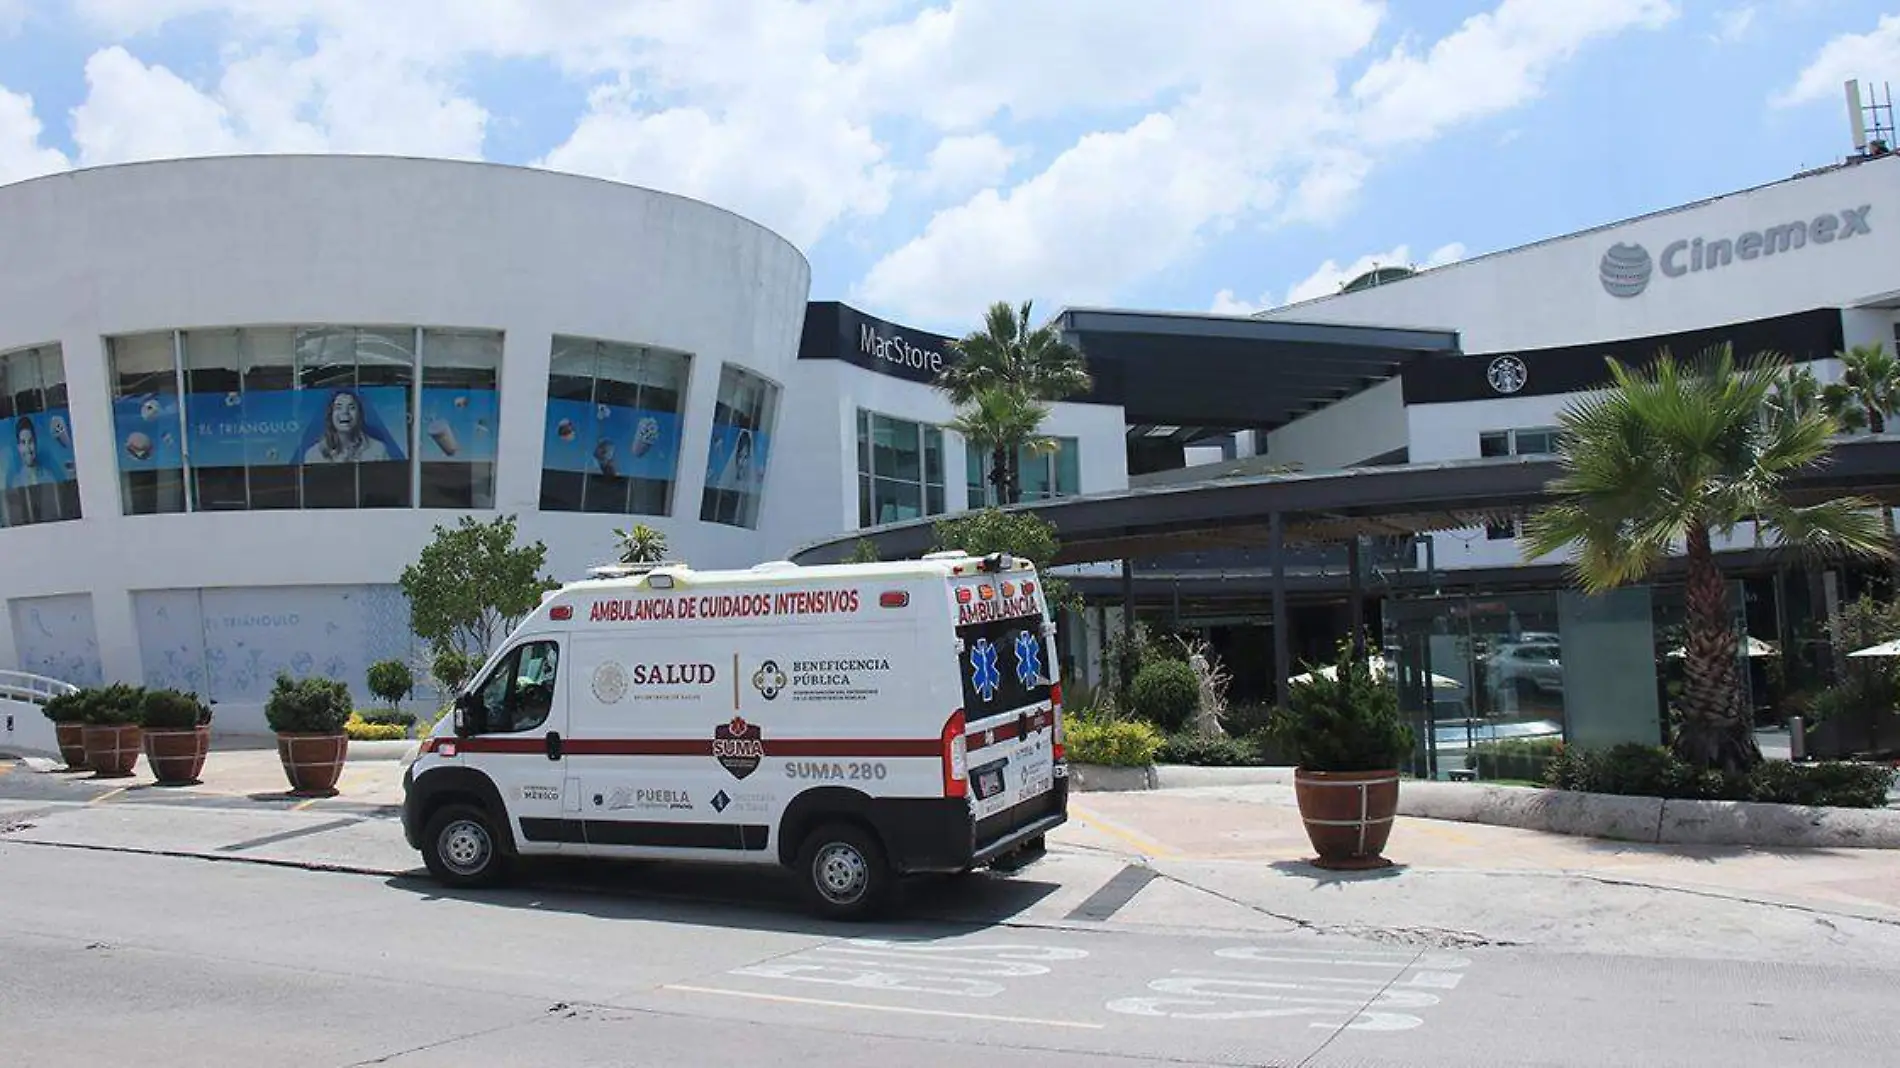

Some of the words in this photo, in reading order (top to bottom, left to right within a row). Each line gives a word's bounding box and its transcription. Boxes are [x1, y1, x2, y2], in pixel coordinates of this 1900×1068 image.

[1660, 205, 1872, 278] Cinemex
[861, 323, 942, 372] MacStore
[590, 600, 674, 622] AMBULANCIA
[678, 597, 696, 618] DE
[699, 594, 771, 617] CUIDADOS
[774, 590, 859, 614] INTENSIVOS
[959, 596, 1039, 624] AMBULANCIA
[634, 664, 716, 684] SALUD
[793, 660, 890, 671] BENEFICENCIA
[793, 673, 850, 685] PÚBLICA
[712, 739, 764, 757] SUMA
[785, 763, 844, 779] SUMA
[849, 763, 887, 780] 280
[637, 789, 690, 802] PUEBLA
